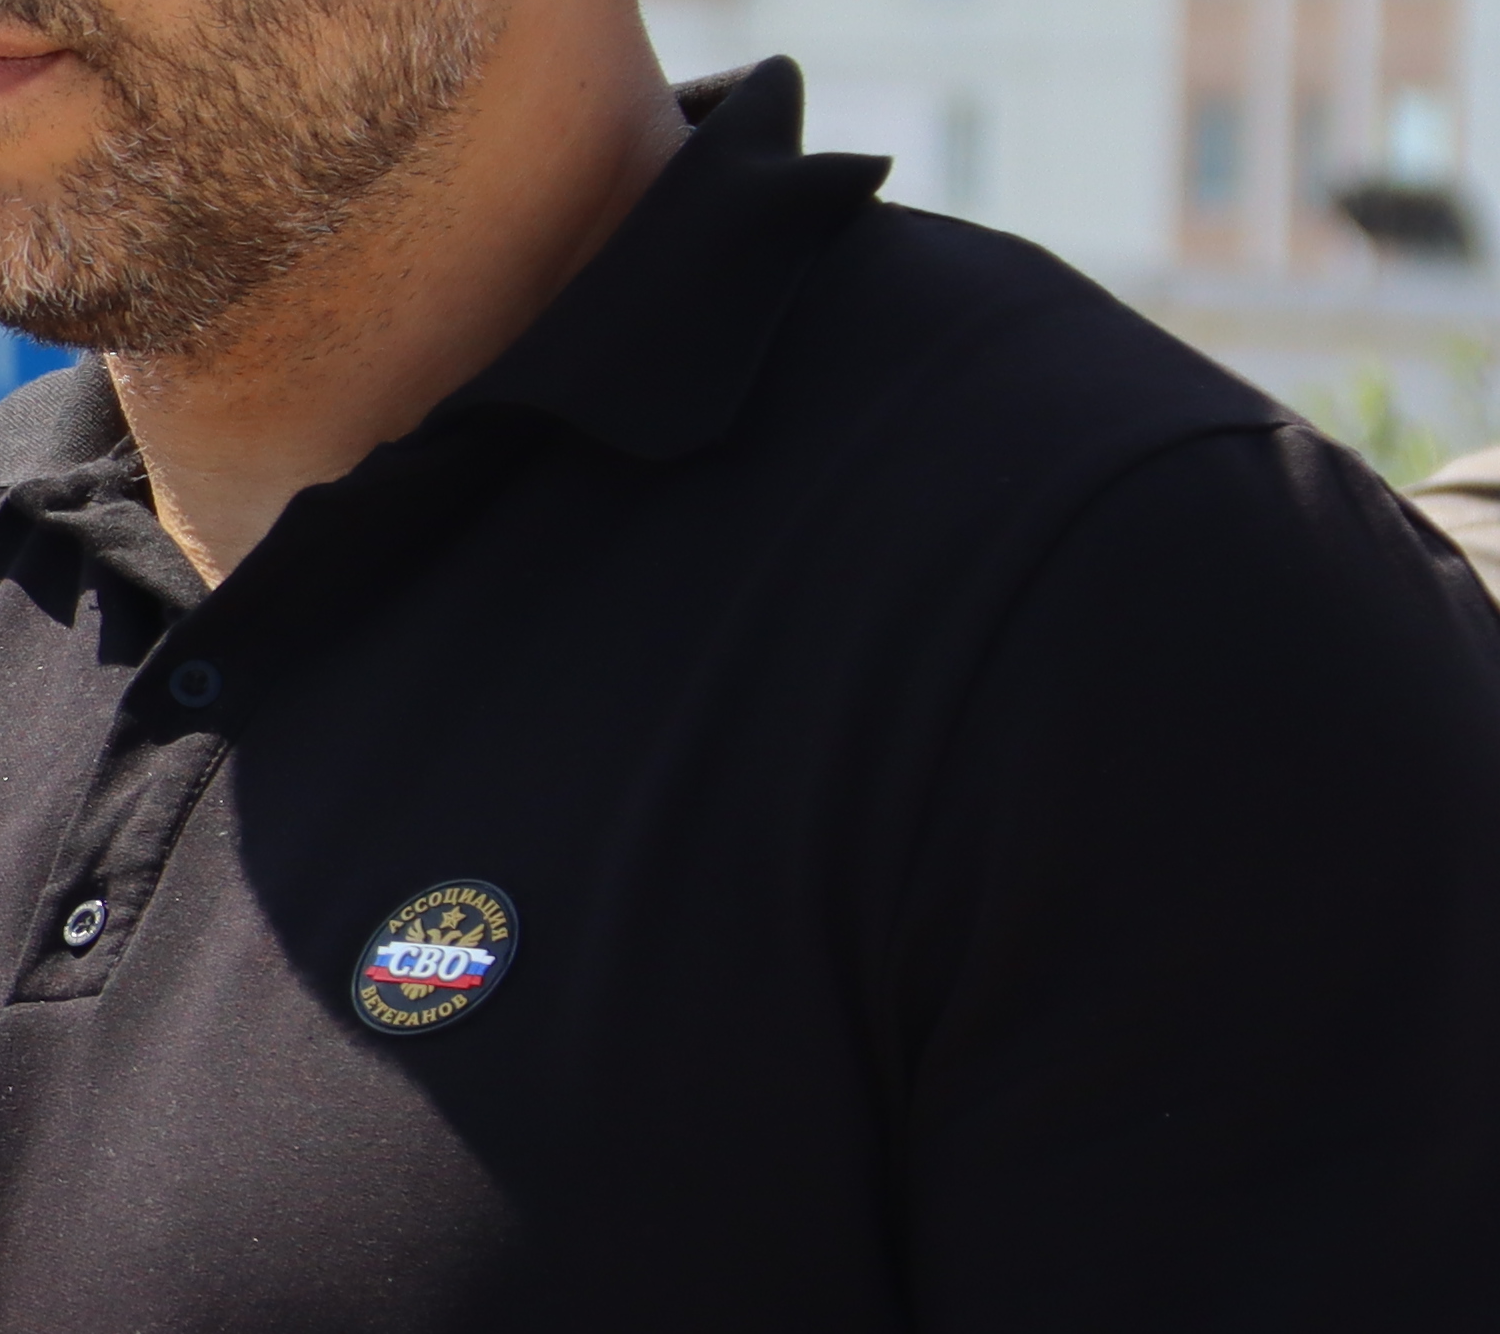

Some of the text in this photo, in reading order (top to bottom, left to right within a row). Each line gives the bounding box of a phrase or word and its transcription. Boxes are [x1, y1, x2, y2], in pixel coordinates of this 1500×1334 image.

[388, 887, 510, 942] АССОЦИАЦИЯ
[388, 944, 473, 982] СВО
[360, 984, 469, 1026] ВЕТЕРАНОВ
